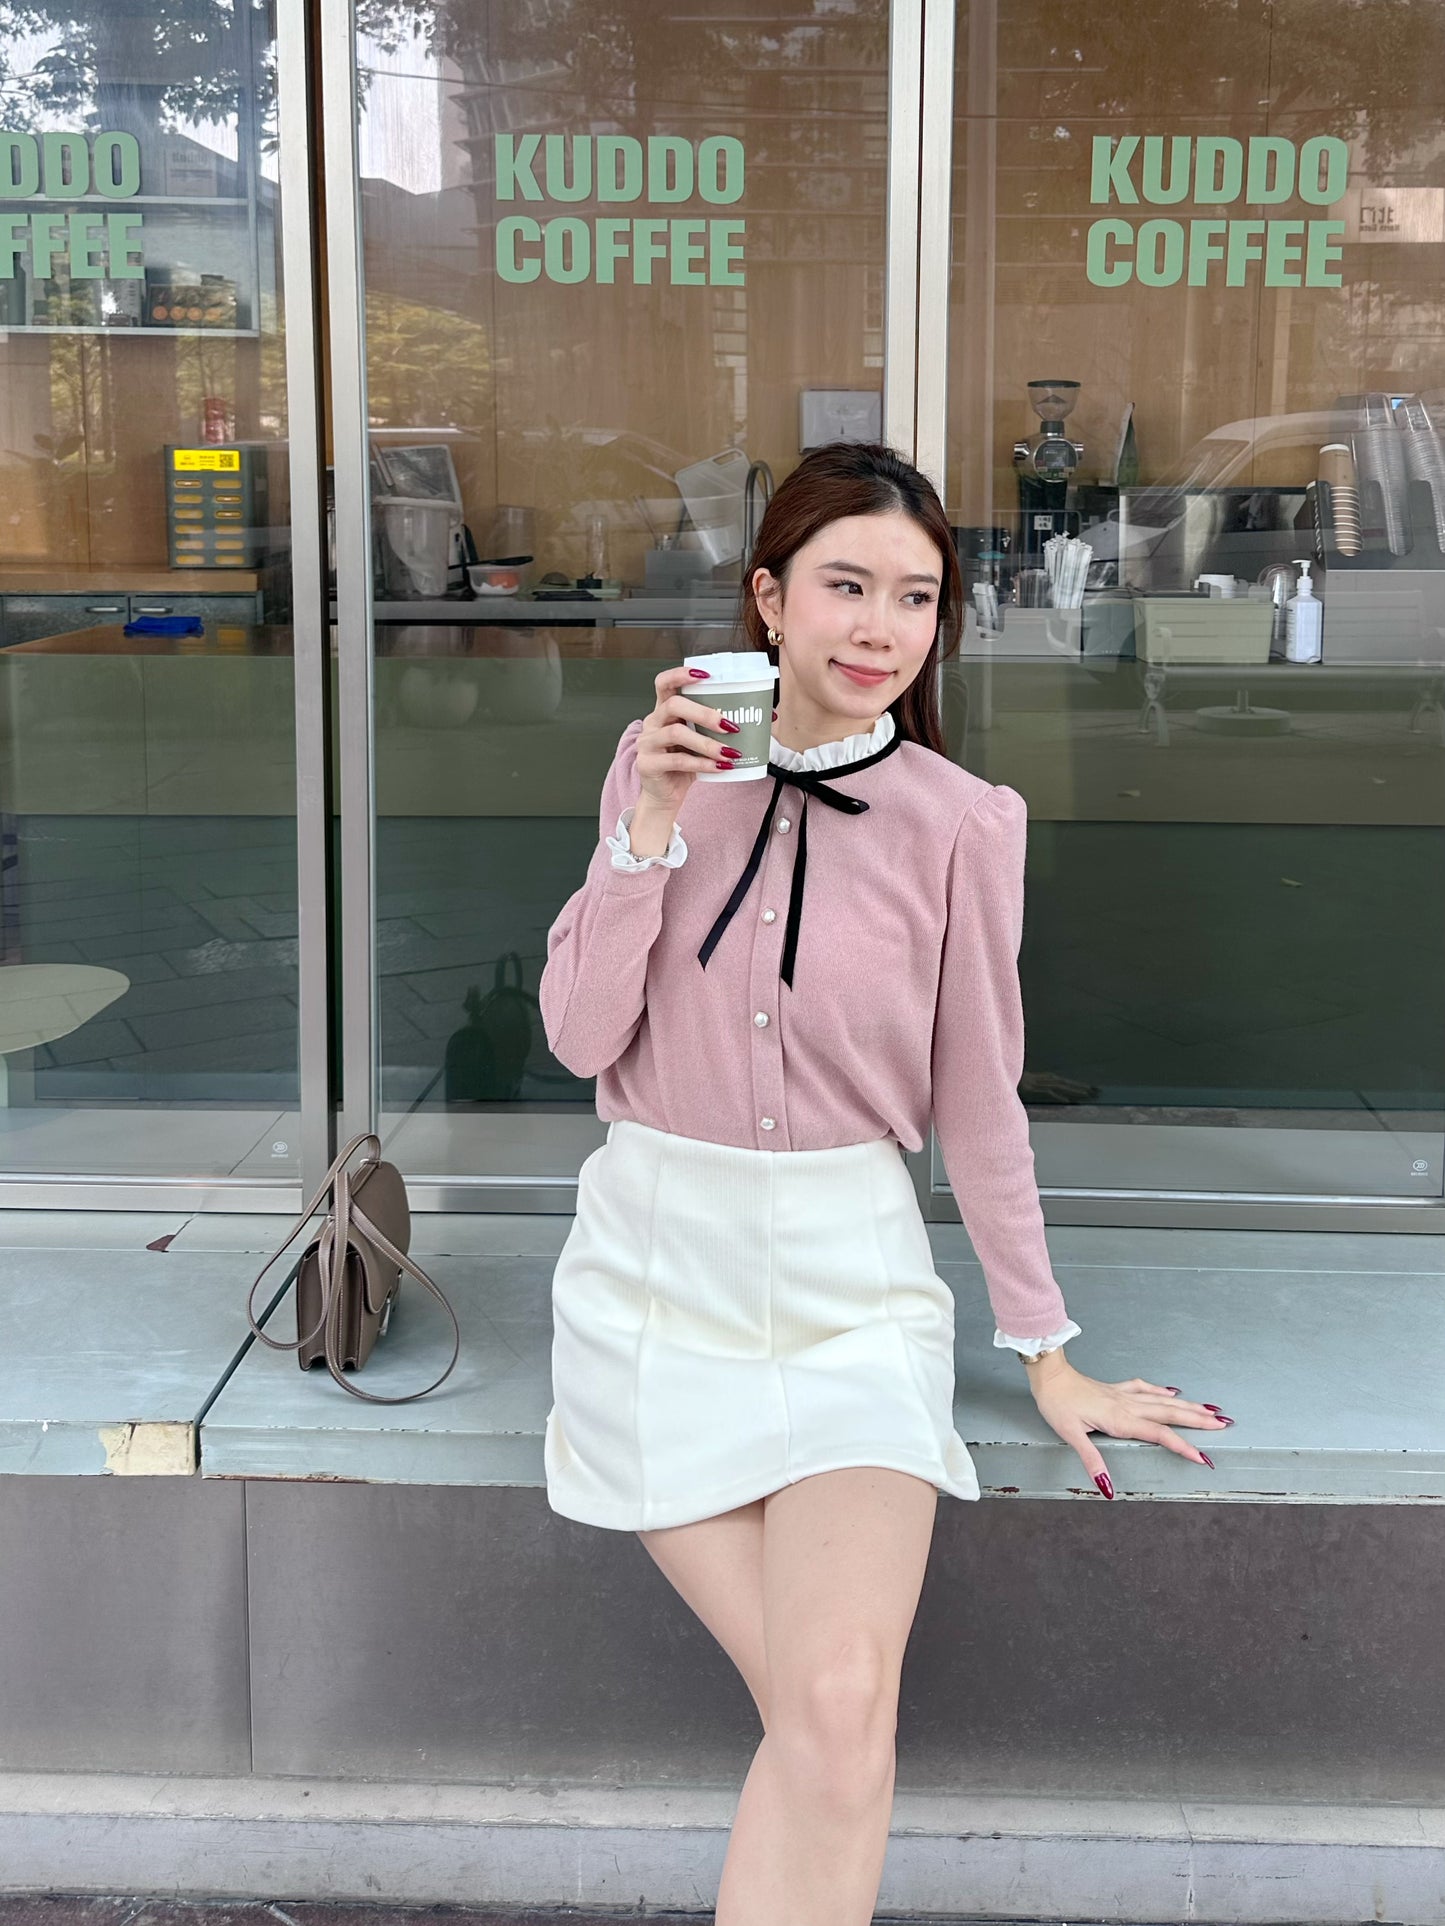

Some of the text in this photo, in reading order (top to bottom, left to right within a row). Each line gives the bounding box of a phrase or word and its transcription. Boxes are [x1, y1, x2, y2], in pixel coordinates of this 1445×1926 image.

[0, 131, 140, 198] DDO
[495, 133, 745, 204] KUDDO
[1090, 134, 1347, 206] KUDDO
[0, 213, 145, 279] FFEE
[496, 215, 745, 286] COFFEE
[1086, 218, 1345, 287] COFFEE
